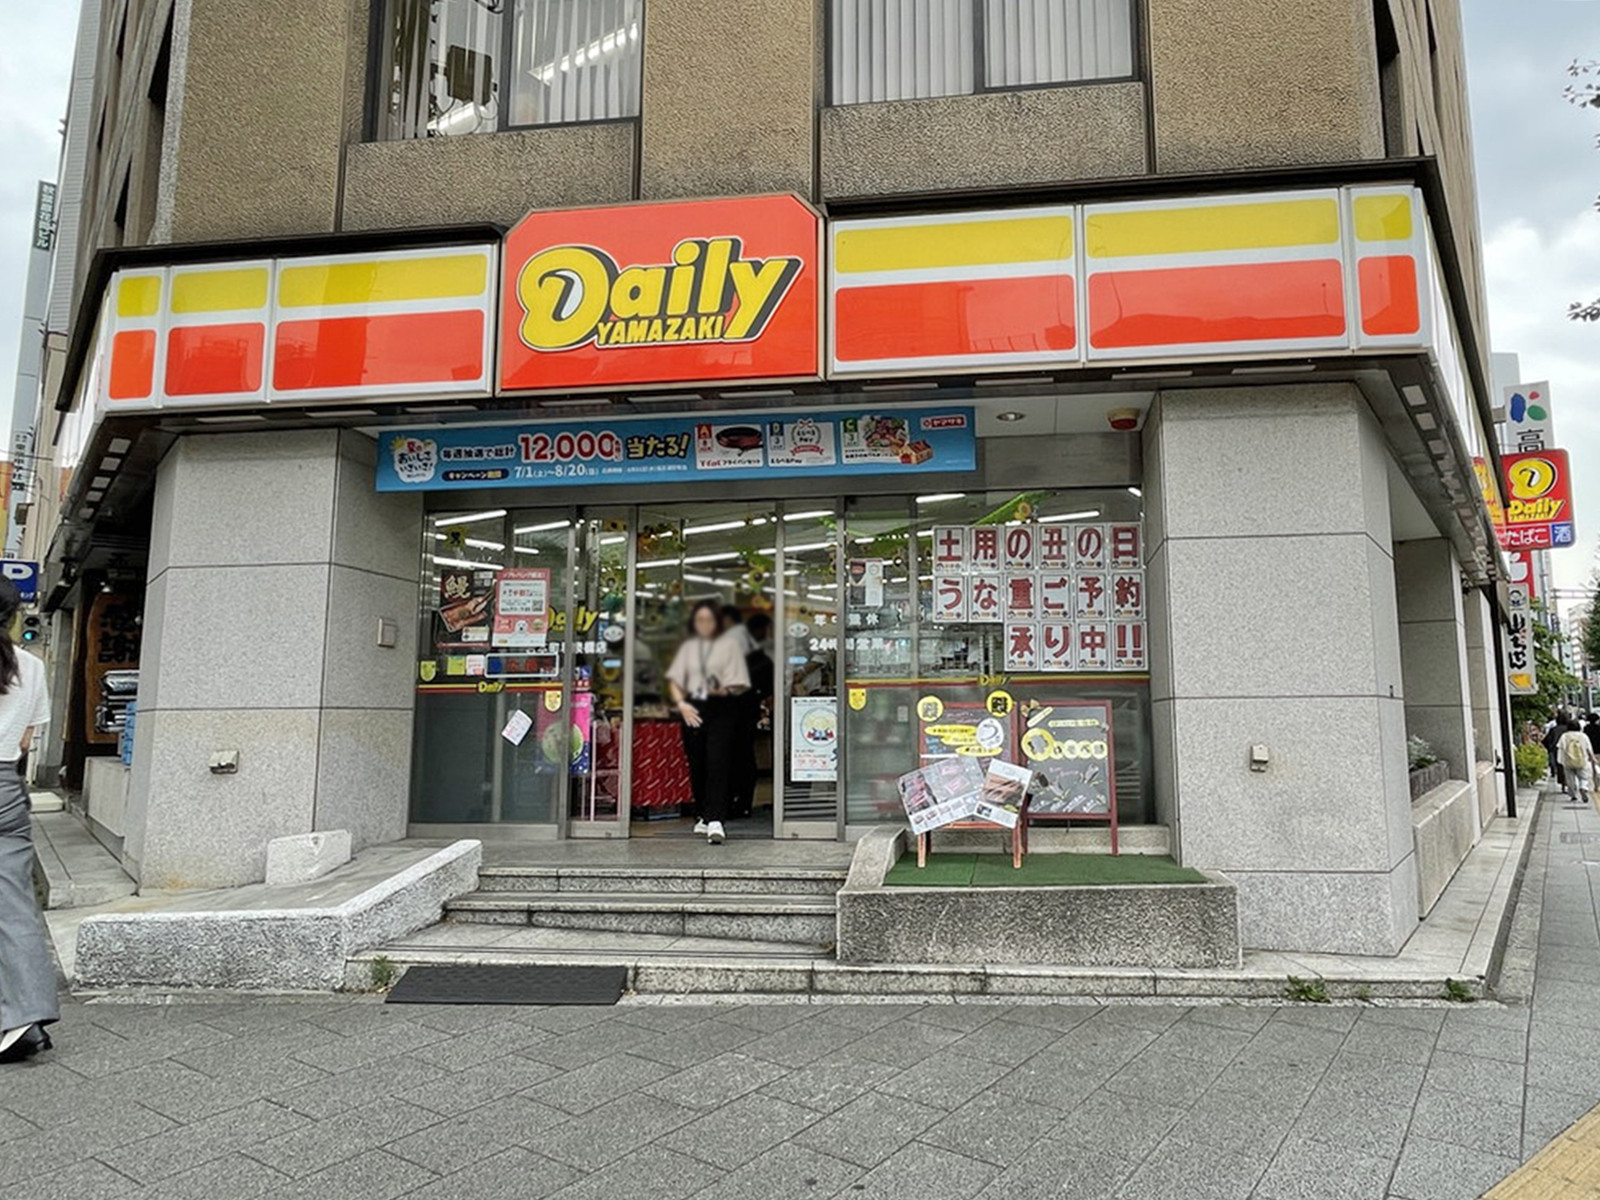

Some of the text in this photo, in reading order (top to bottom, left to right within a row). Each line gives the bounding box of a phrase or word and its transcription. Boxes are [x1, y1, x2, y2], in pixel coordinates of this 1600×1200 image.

[518, 236, 802, 349] Daily
[597, 315, 724, 345] YAMAZAKI
[519, 433, 616, 461] 12,000
[627, 434, 690, 458] 当たる!
[1509, 498, 1564, 521] Daily
[937, 526, 1138, 562] 土用の丑の日
[1507, 526, 1573, 546] たばこ 酒
[938, 575, 1141, 610] うな重ご予約
[1010, 624, 1142, 659] 承り中!!
